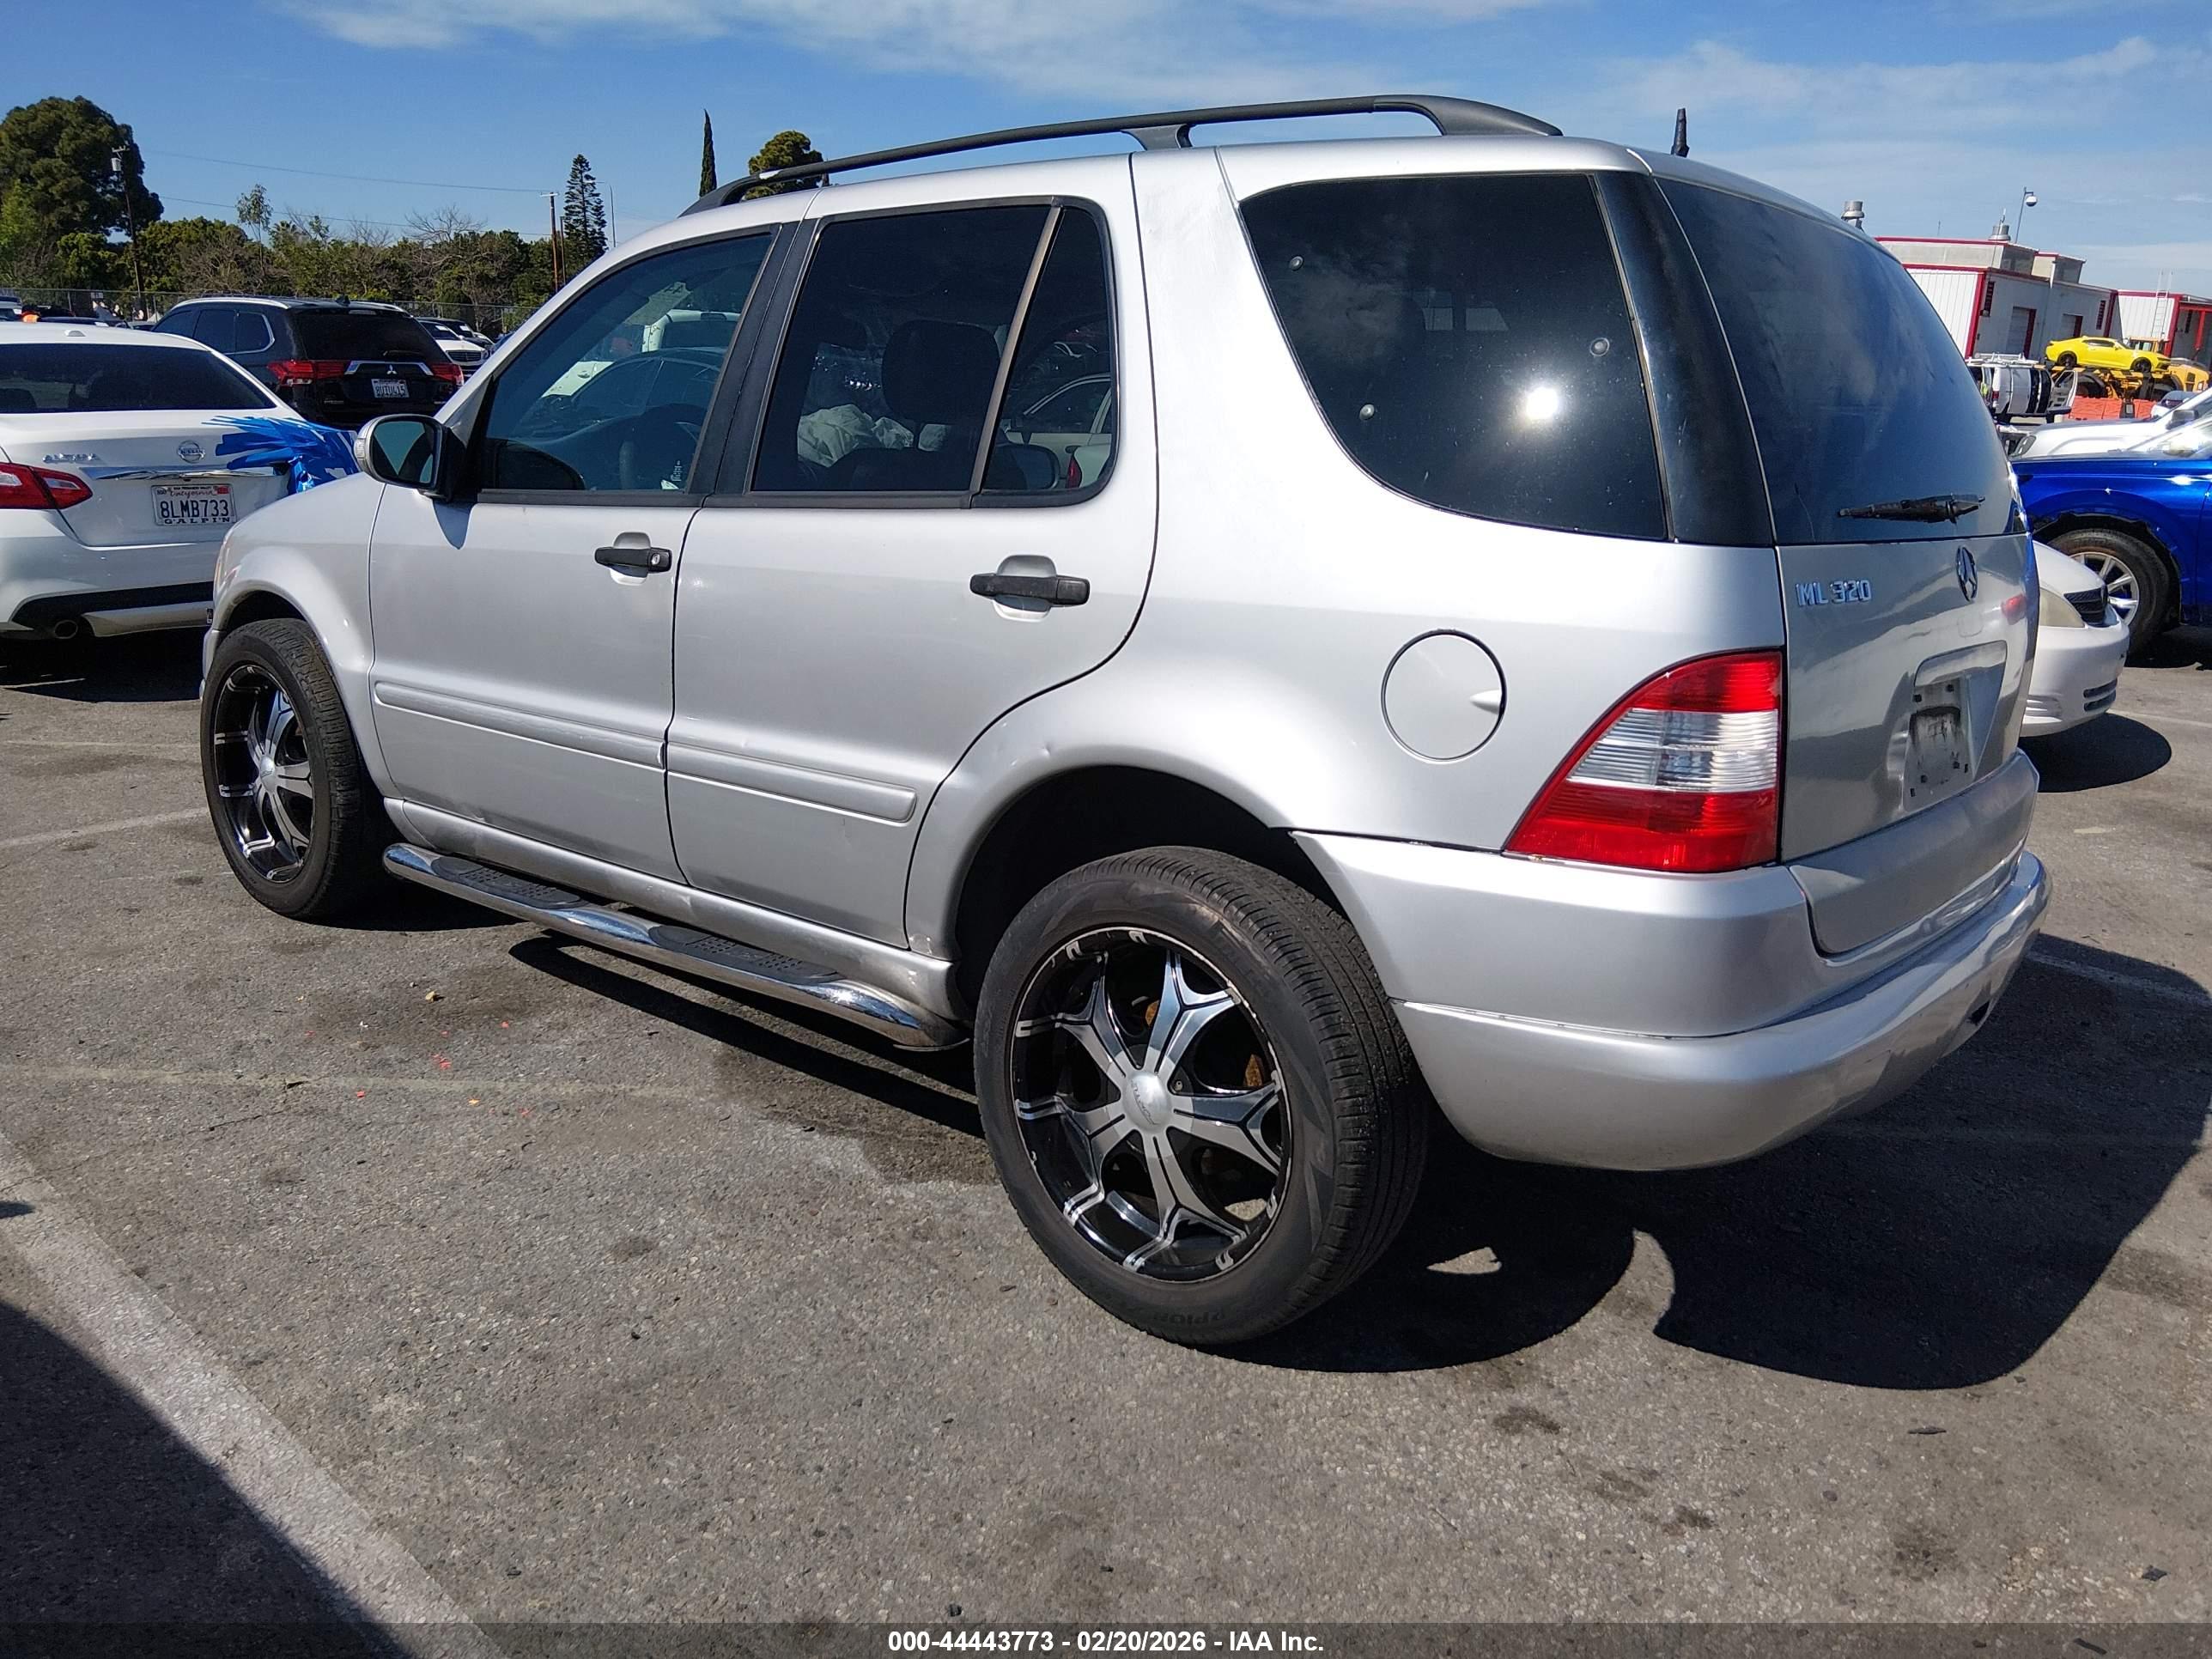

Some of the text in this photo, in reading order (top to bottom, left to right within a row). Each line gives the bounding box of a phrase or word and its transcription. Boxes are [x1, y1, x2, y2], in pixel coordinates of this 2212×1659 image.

[160, 499, 229, 519] 8LMB733
[1796, 579, 1872, 606] ML 320
